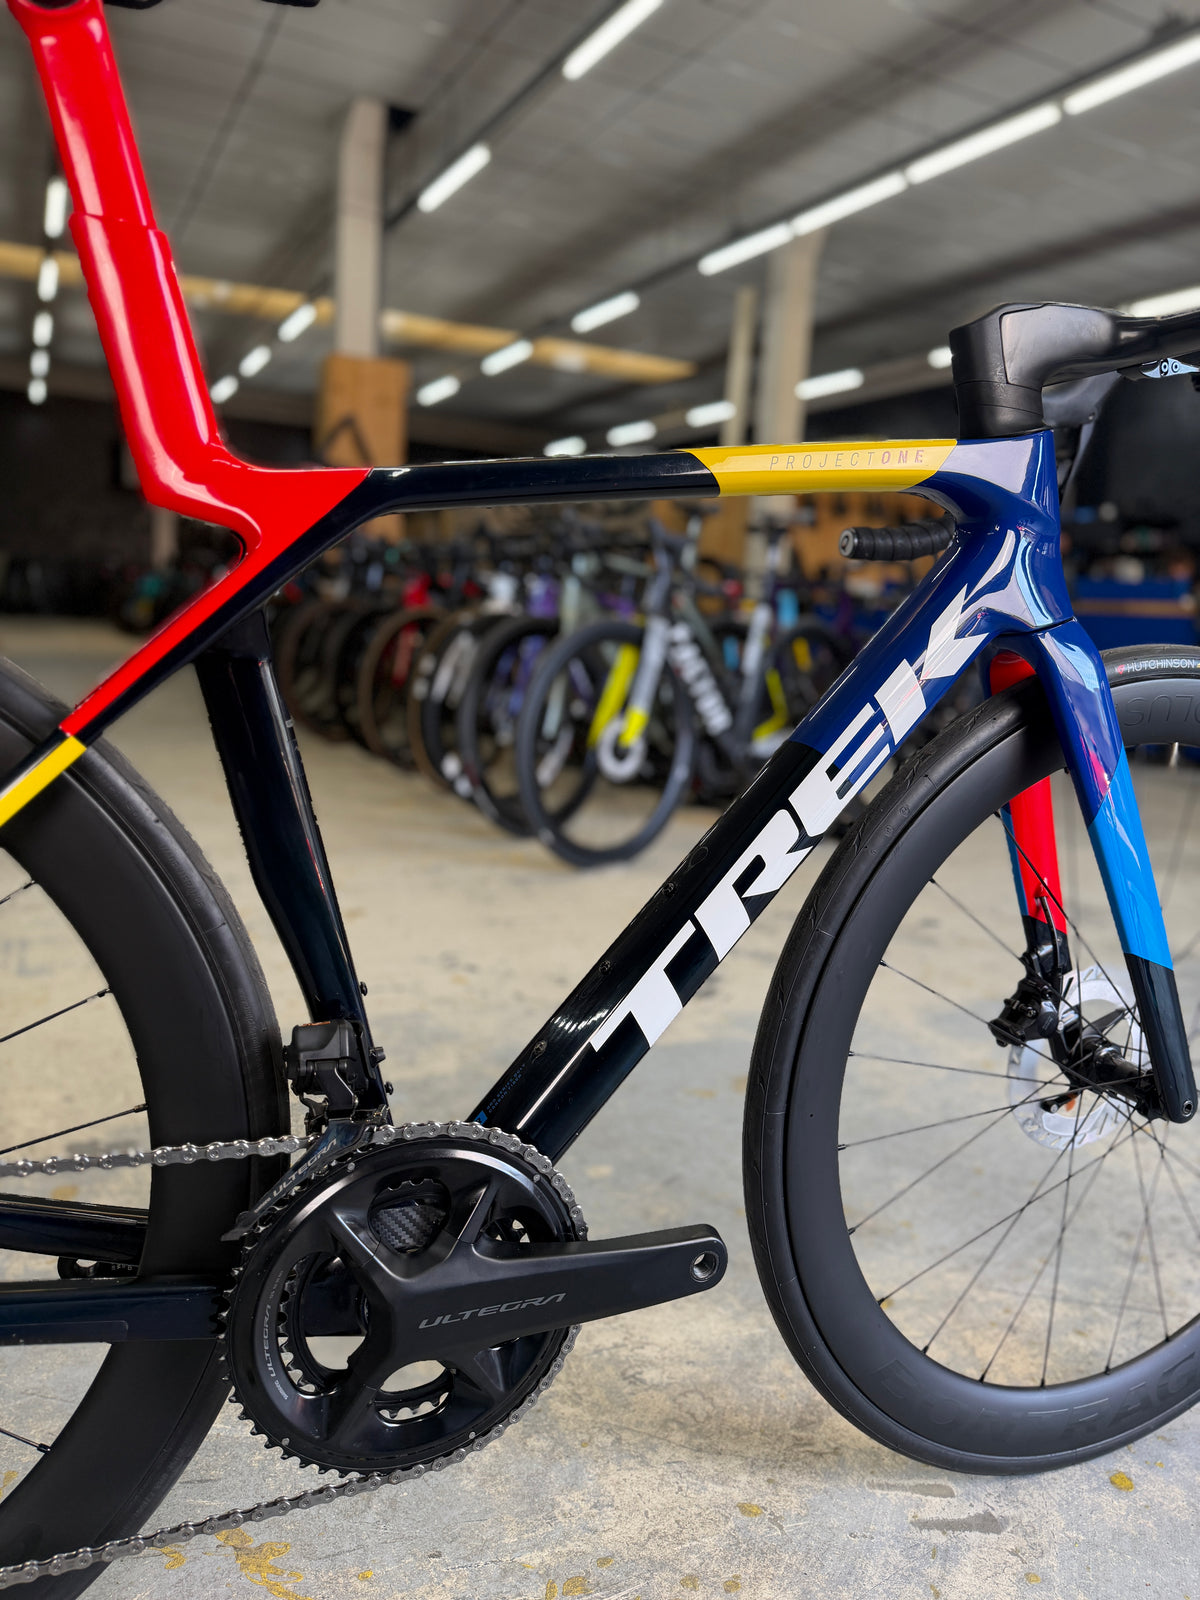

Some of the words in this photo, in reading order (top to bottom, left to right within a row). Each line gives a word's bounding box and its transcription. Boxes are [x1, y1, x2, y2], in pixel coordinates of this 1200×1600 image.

[1127, 658, 1195, 673] HUTCHINSON
[1123, 694, 1200, 727] LUS
[591, 583, 989, 1052] TREK
[273, 1138, 337, 1197] ULTEGRA
[418, 1292, 567, 1330] ULTEGRA
[263, 1304, 276, 1378] ULTEGRA
